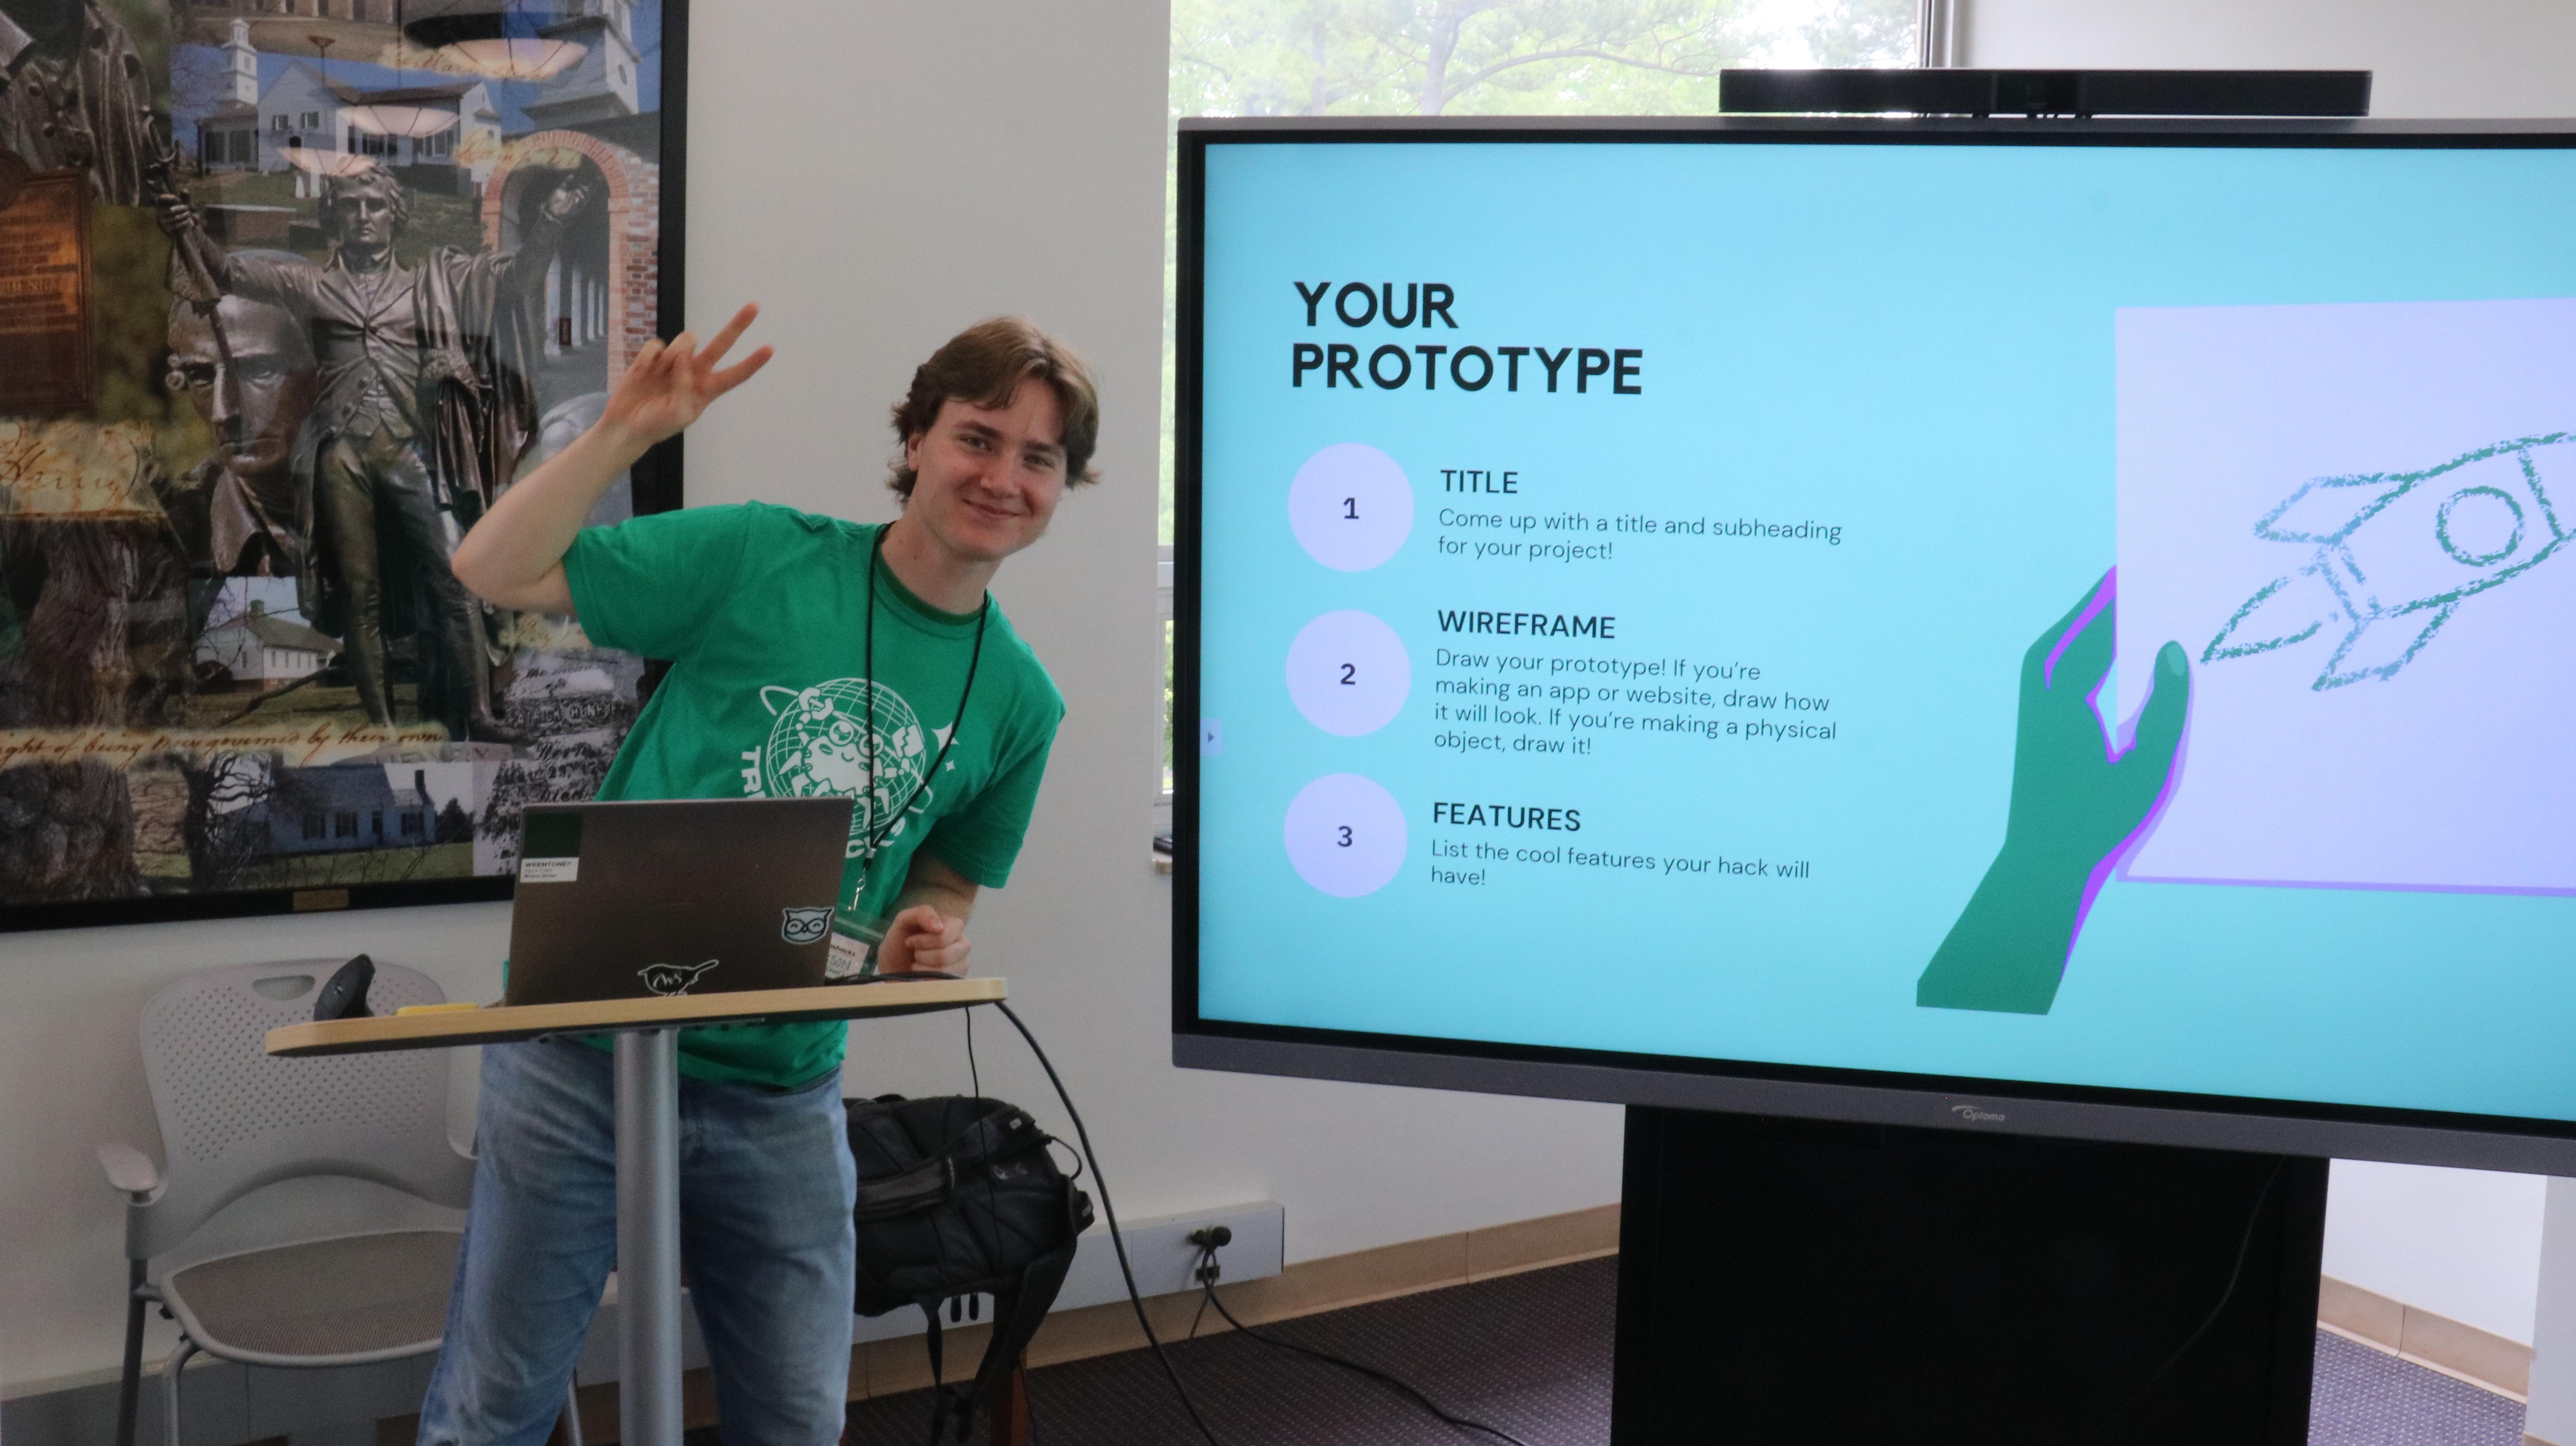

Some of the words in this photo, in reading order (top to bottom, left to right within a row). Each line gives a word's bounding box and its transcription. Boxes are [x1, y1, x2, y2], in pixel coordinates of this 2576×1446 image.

[1293, 281, 1458, 328] YOUR
[1292, 343, 1643, 395] PROTOTYPE
[1440, 469, 1518, 494] TITLE
[1343, 497, 1360, 520] 1
[1439, 508, 1502, 528] Come
[1510, 516, 1536, 534] up
[1544, 512, 1589, 530] with
[1596, 519, 1607, 531] a
[1616, 514, 1657, 533] title
[1665, 517, 1705, 535] and
[1713, 518, 1842, 546] subheading
[1439, 536, 1467, 554] for
[1475, 543, 1522, 560] your
[1529, 541, 1612, 563] project!
[1437, 610, 1616, 639] WIREFRAME
[1340, 663, 1356, 686] 2
[1437, 649, 1489, 667] Draw
[1497, 656, 1543, 673] your
[1551, 658, 1665, 680] prototype!
[1674, 659, 1686, 676] If
[1436, 677, 1510, 702] making
[1518, 684, 1542, 697] an
[1550, 686, 1590, 704] app
[1598, 688, 1619, 701] or
[1627, 686, 1715, 708] website,
[1723, 690, 1777, 708] draw
[1785, 692, 1829, 711] how
[1435, 702, 1448, 720] it
[1456, 705, 1486, 722] will
[1495, 706, 1542, 724] look.
[1550, 708, 1561, 725] If
[1642, 714, 1719, 739] making
[1726, 722, 1738, 735] a
[1746, 719, 1836, 742] physical
[1434, 730, 1505, 753] object,
[1513, 734, 1564, 753] draw
[1573, 737, 1590, 754] it!
[1434, 802, 1581, 832] FEATURES
[1337, 825, 1353, 848] 3
[1432, 839, 1467, 858] List
[1476, 842, 1509, 860] the
[1516, 847, 1560, 863] cool
[1568, 847, 1656, 869] features
[1663, 858, 1711, 875] your
[1719, 856, 1768, 876] hack
[1777, 860, 1809, 878] will
[1432, 866, 1485, 885] have!
[1962, 1109, 2005, 1122] Optoma
